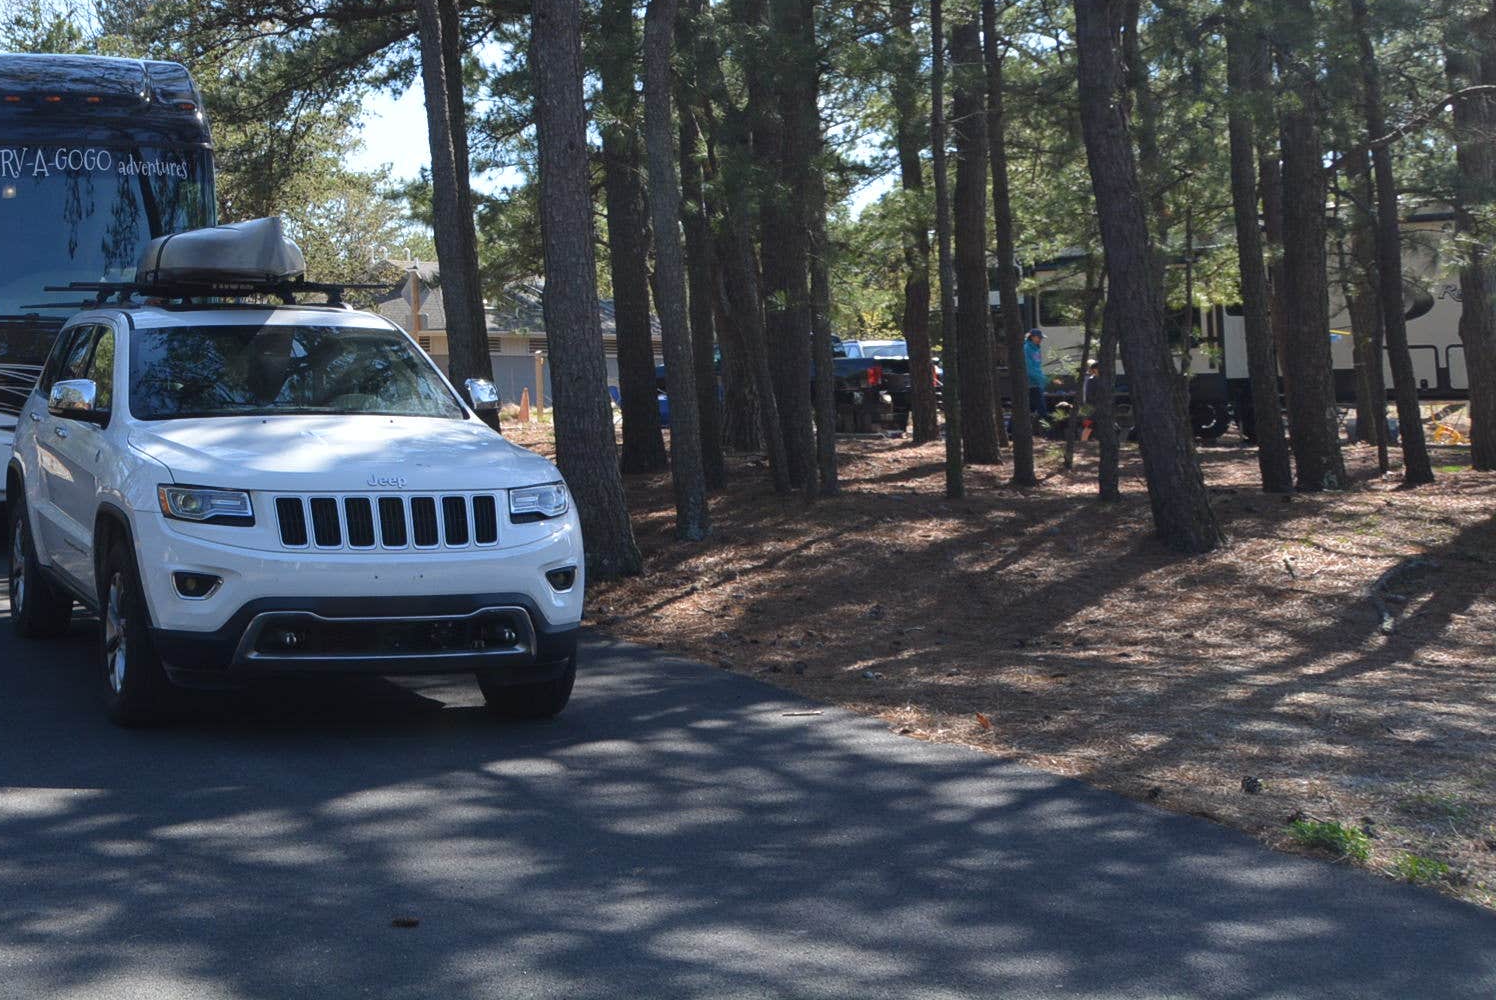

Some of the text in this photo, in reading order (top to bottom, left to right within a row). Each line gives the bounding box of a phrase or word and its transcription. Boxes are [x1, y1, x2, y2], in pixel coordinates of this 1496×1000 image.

[0, 148, 112, 178] RV-A-GOGO
[118, 154, 188, 178] adventures
[367, 473, 407, 488] Jeep
